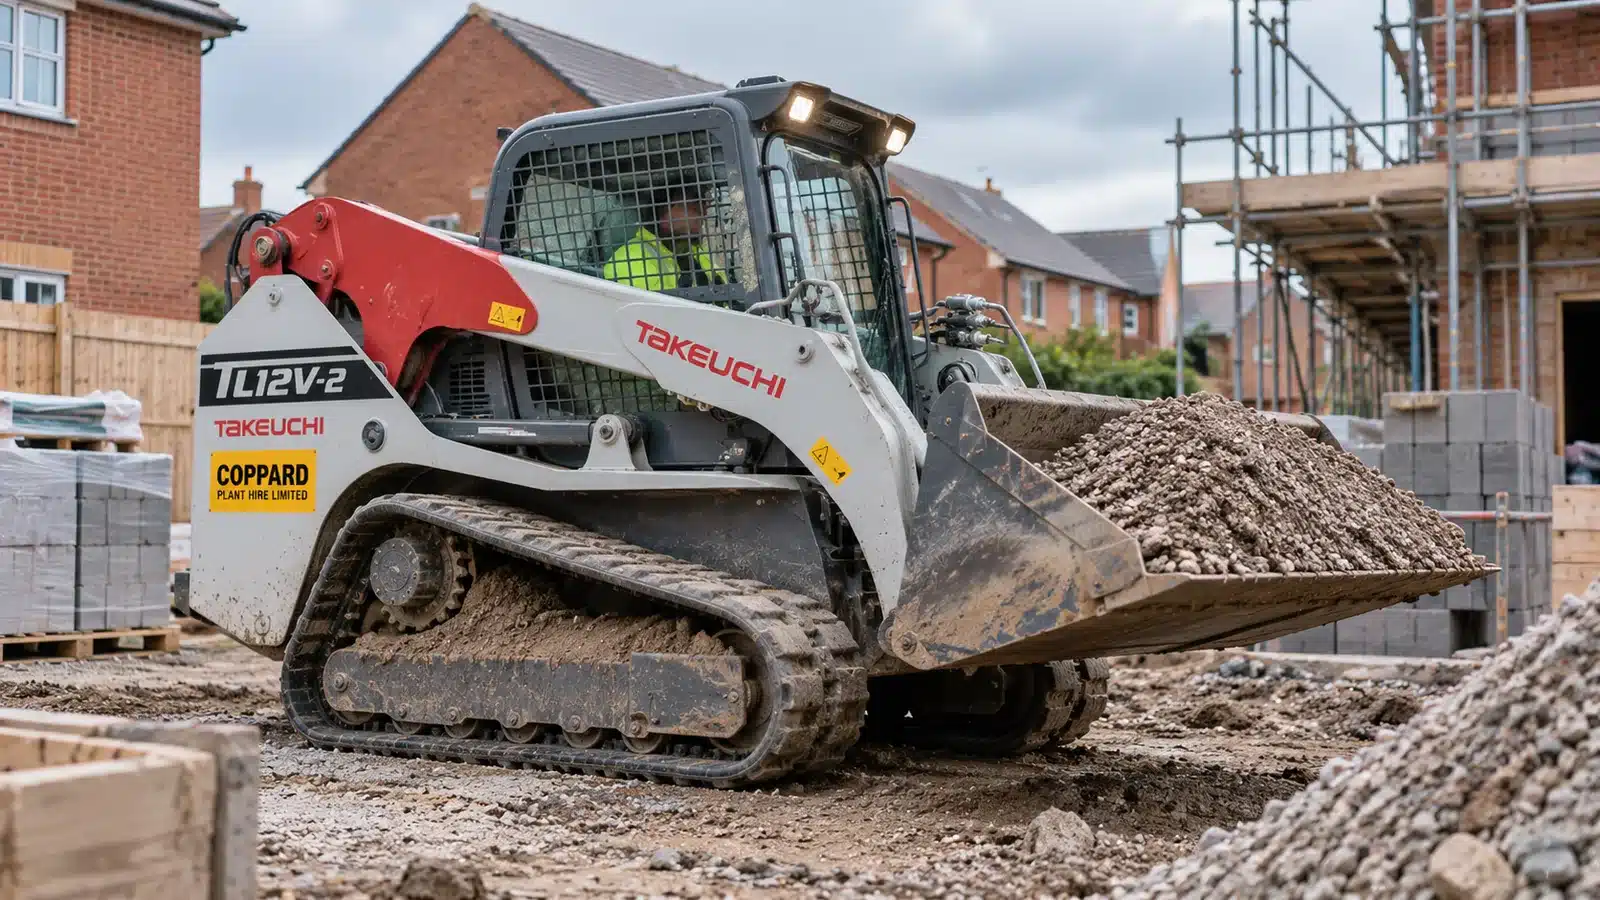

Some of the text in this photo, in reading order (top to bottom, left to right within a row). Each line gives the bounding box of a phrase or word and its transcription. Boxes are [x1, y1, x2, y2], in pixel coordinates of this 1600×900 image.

[214, 363, 347, 399] TL12V-2
[216, 463, 309, 487] COPPARD
[216, 489, 308, 501] PLANT HIRE LIMITED
